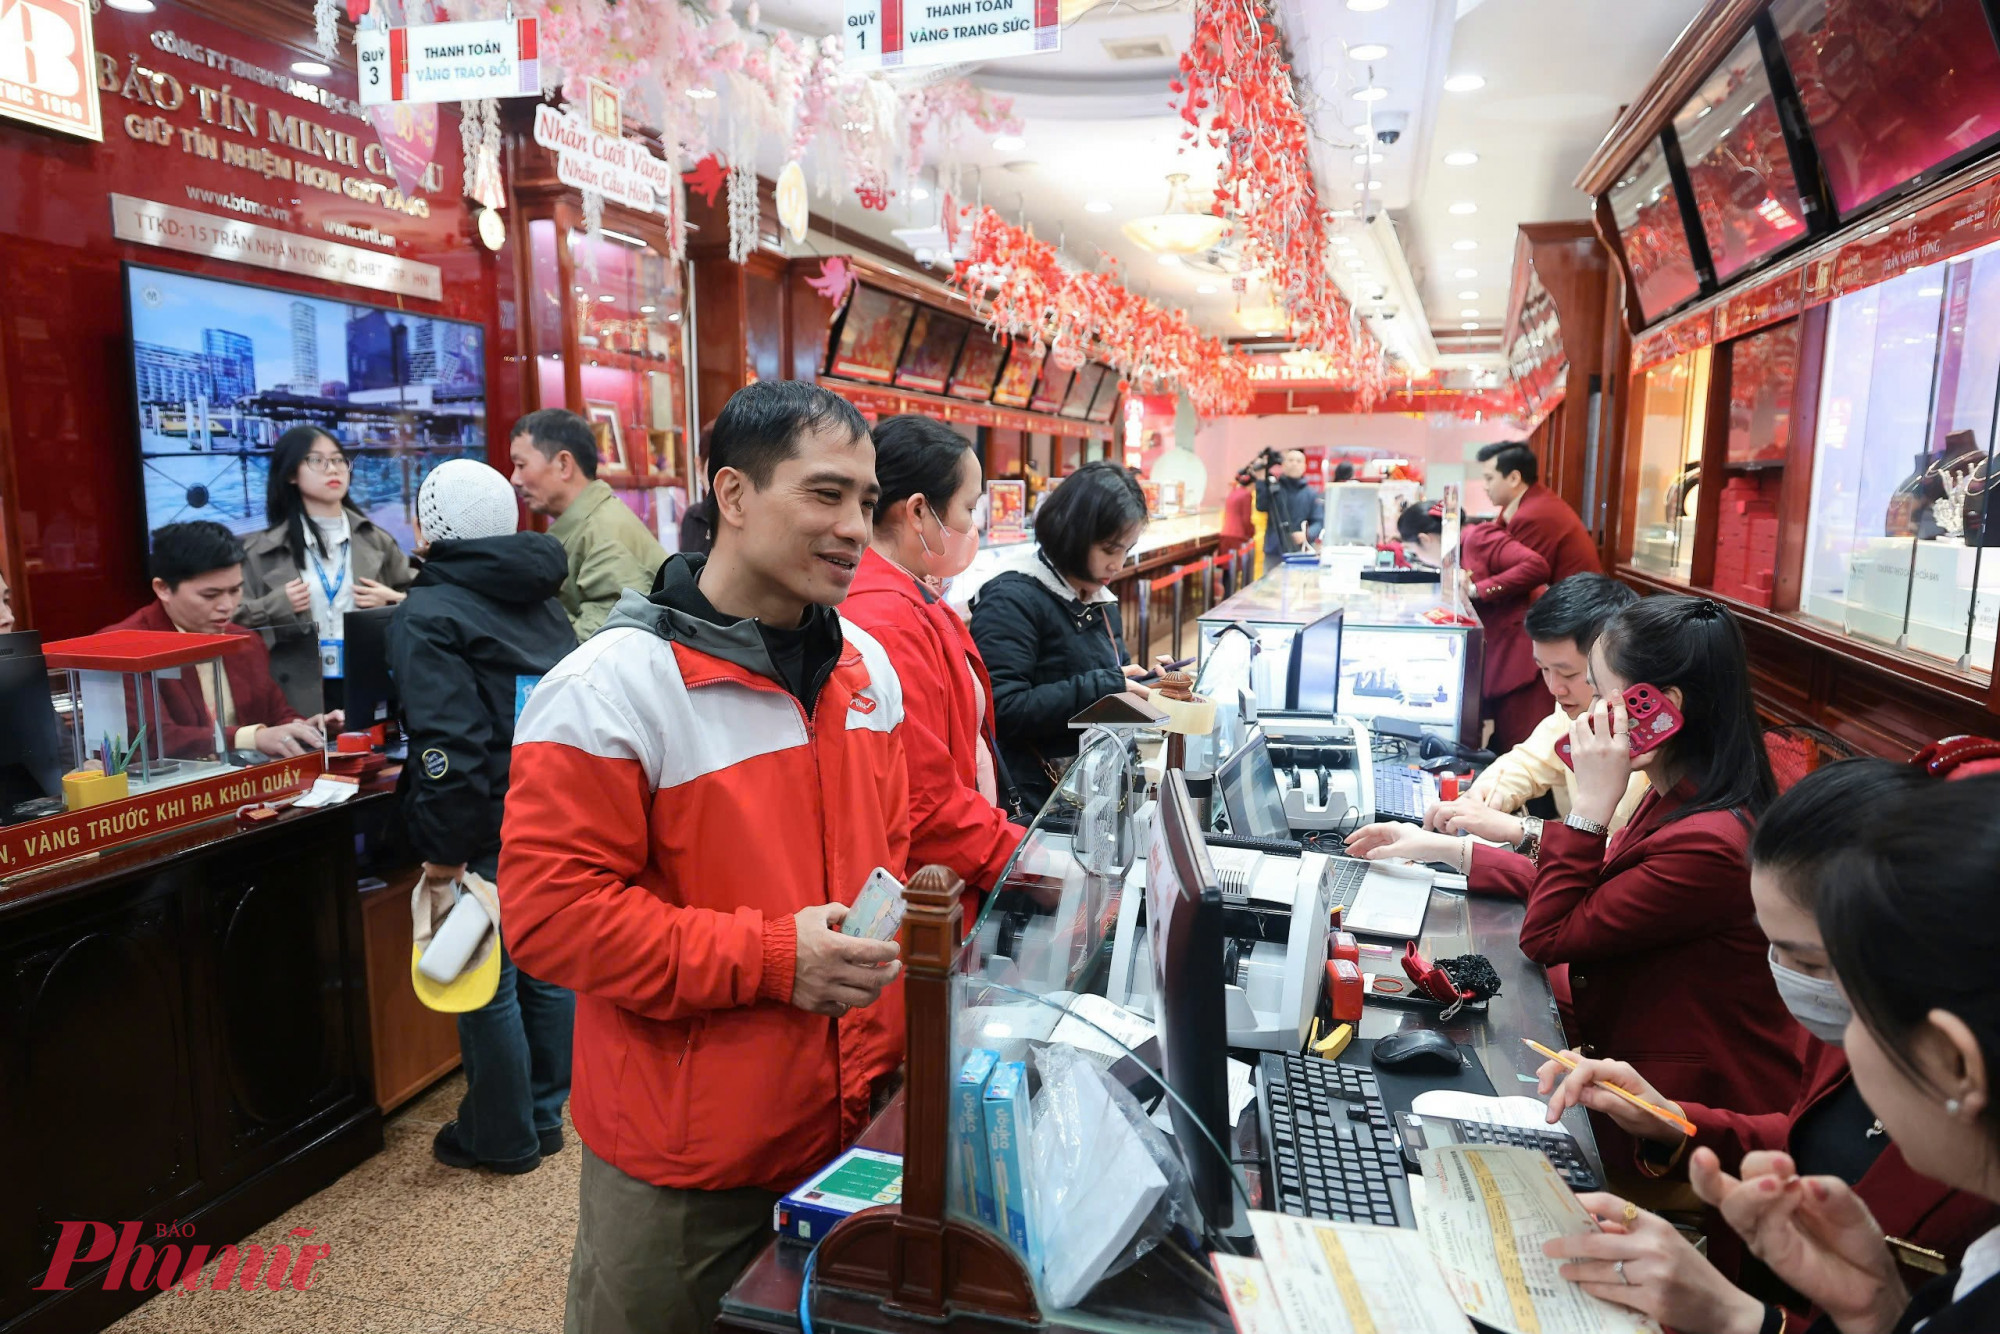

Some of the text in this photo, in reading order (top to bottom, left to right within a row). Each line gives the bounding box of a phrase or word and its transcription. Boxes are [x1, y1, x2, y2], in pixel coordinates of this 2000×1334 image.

[847, 12, 876, 27] QUỸ
[926, 3, 971, 19] THANH
[856, 30, 866, 50] 1
[910, 16, 1030, 43] VÀNG TRANG SỨC
[150, 30, 204, 63] CÔNG
[205, 48, 228, 70] TY
[361, 47, 385, 62] QUỸ
[424, 40, 501, 59] THANH TOÁN
[369, 66, 379, 85] 3
[416, 58, 511, 82] VÀNG TRAO ĐỔI
[95, 50, 184, 111] BẢO
[189, 84, 258, 140] TÍN
[267, 107, 358, 168] MINH
[124, 113, 174, 147] GIỮ
[178, 126, 219, 160] TÍN
[222, 140, 292, 181] NHIỆM
[294, 160, 342, 194] HƠN
[540, 112, 588, 152] Nhẫn
[632, 148, 669, 189] Vàng
[563, 156, 599, 186] Nhẫn
[185, 184, 290, 223] www.btmc.vn
[134, 211, 184, 238] TTKD:
[190, 226, 207, 242] 15
[1907, 225, 1918, 244] 15
[24, 828, 80, 858] VÀNG
[87, 807, 150, 841] TRƯỚC
[157, 799, 186, 823] KHI
[192, 790, 214, 812] RA
[219, 776, 257, 804] KHỎI
[262, 768, 302, 793] QUẦY
